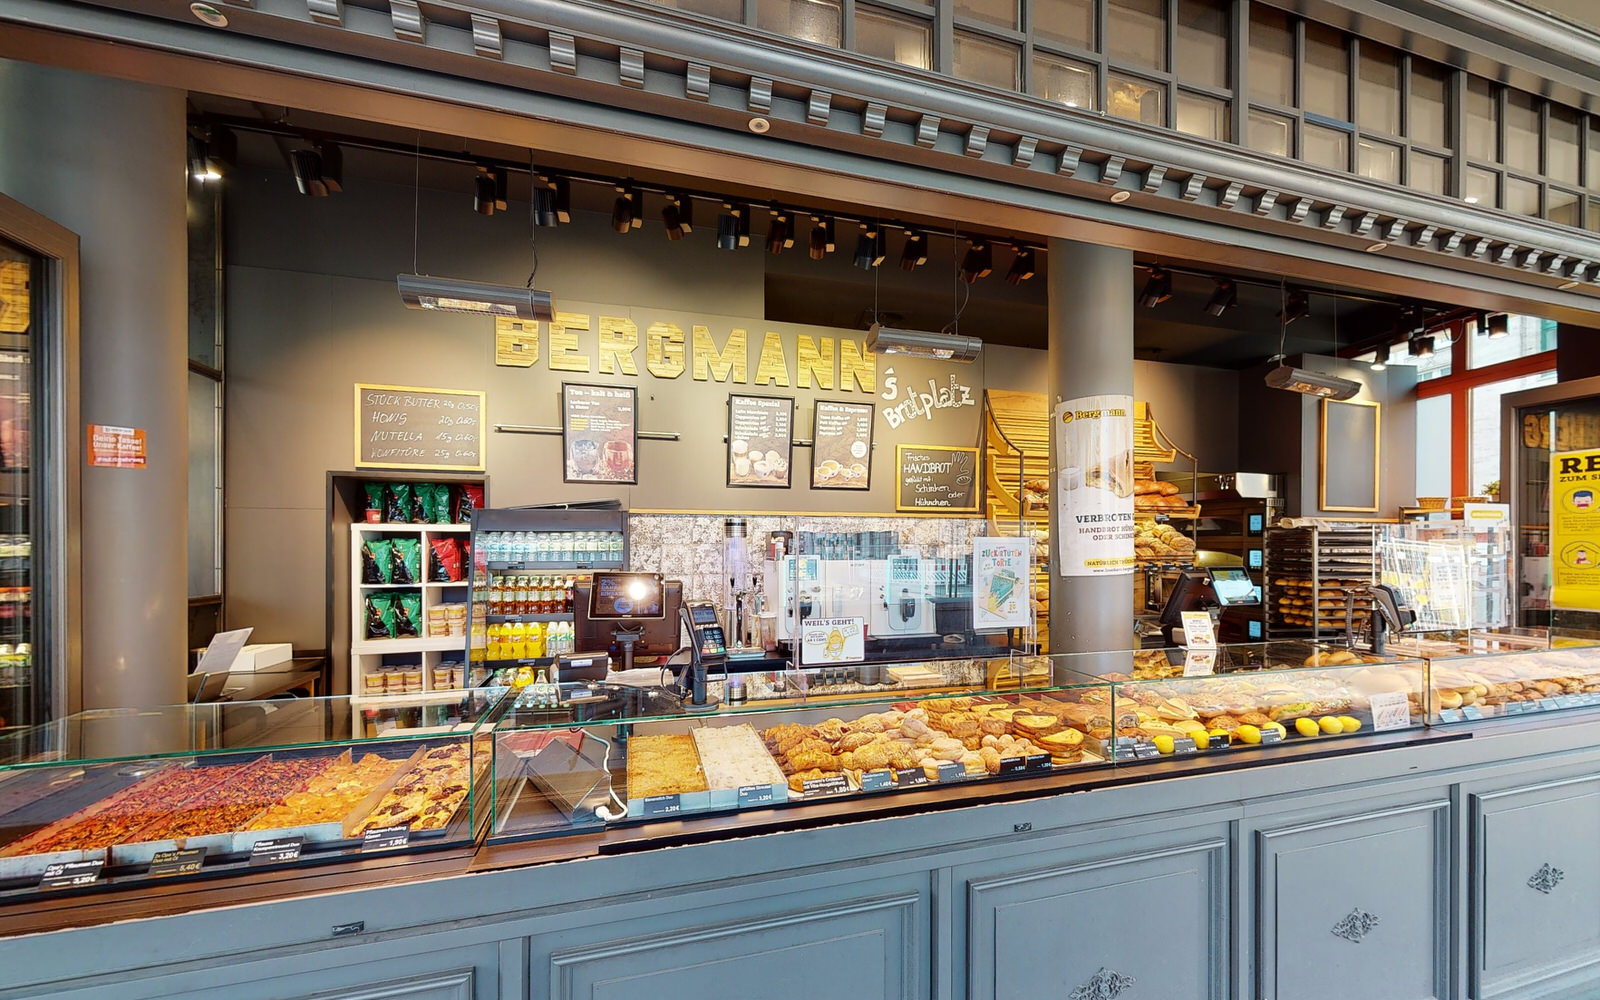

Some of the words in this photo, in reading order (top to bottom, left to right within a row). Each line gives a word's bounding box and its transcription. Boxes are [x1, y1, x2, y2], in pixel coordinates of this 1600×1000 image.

[495, 312, 877, 394] BERGMANN
[367, 393, 401, 406] STÜCK
[403, 395, 441, 408] BUTTER
[882, 374, 975, 429] Brotplatz
[372, 411, 408, 425] HONIG
[1075, 408, 1126, 421] Bergmann
[370, 430, 423, 442] NUTELLA
[903, 462, 952, 474] HANDBROT
[915, 483, 951, 493] Schinken
[948, 491, 966, 499] oder
[915, 497, 951, 506] Hühnchen
[1076, 512, 1131, 523] VERBROTEN
